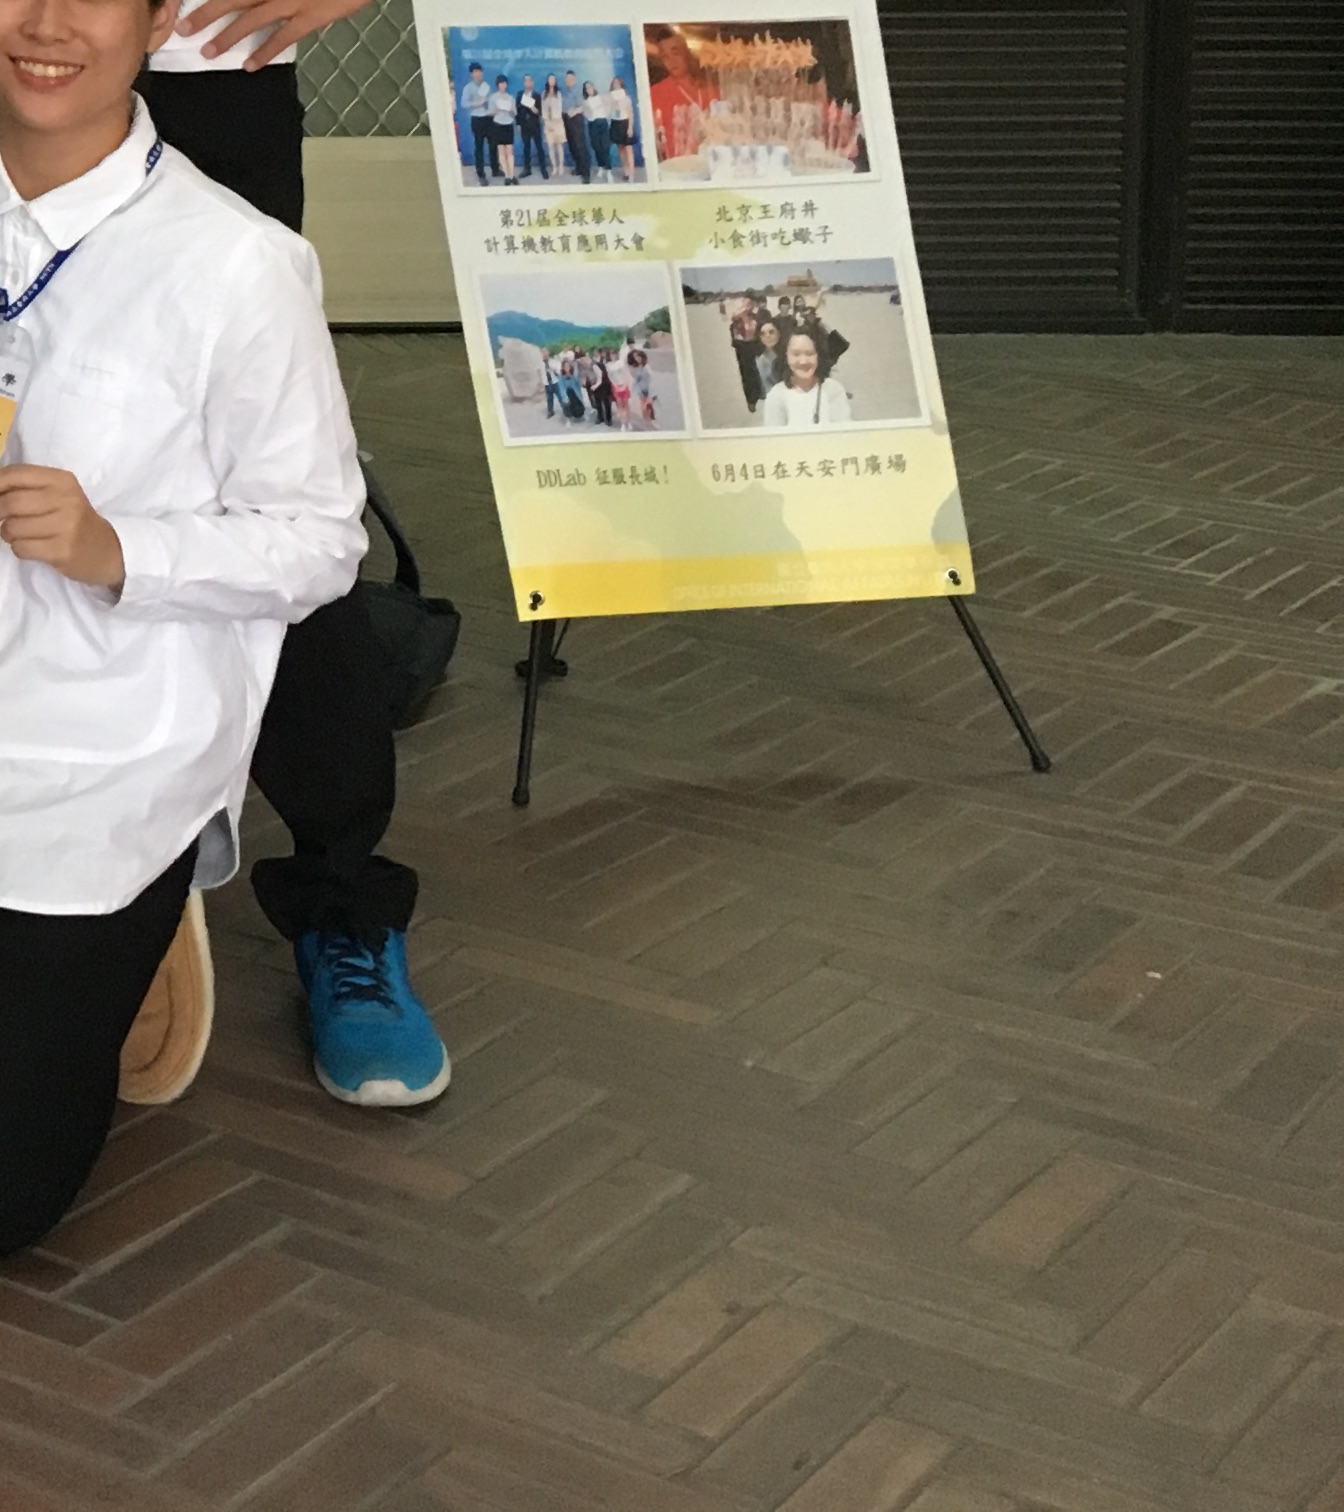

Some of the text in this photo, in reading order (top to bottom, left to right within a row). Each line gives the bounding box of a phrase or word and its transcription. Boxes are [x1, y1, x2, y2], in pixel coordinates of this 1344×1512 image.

[715, 199, 819, 223] 北京王府井
[537, 467, 587, 489] DDLab
[711, 453, 908, 483] 6月4日在天安門廣場
